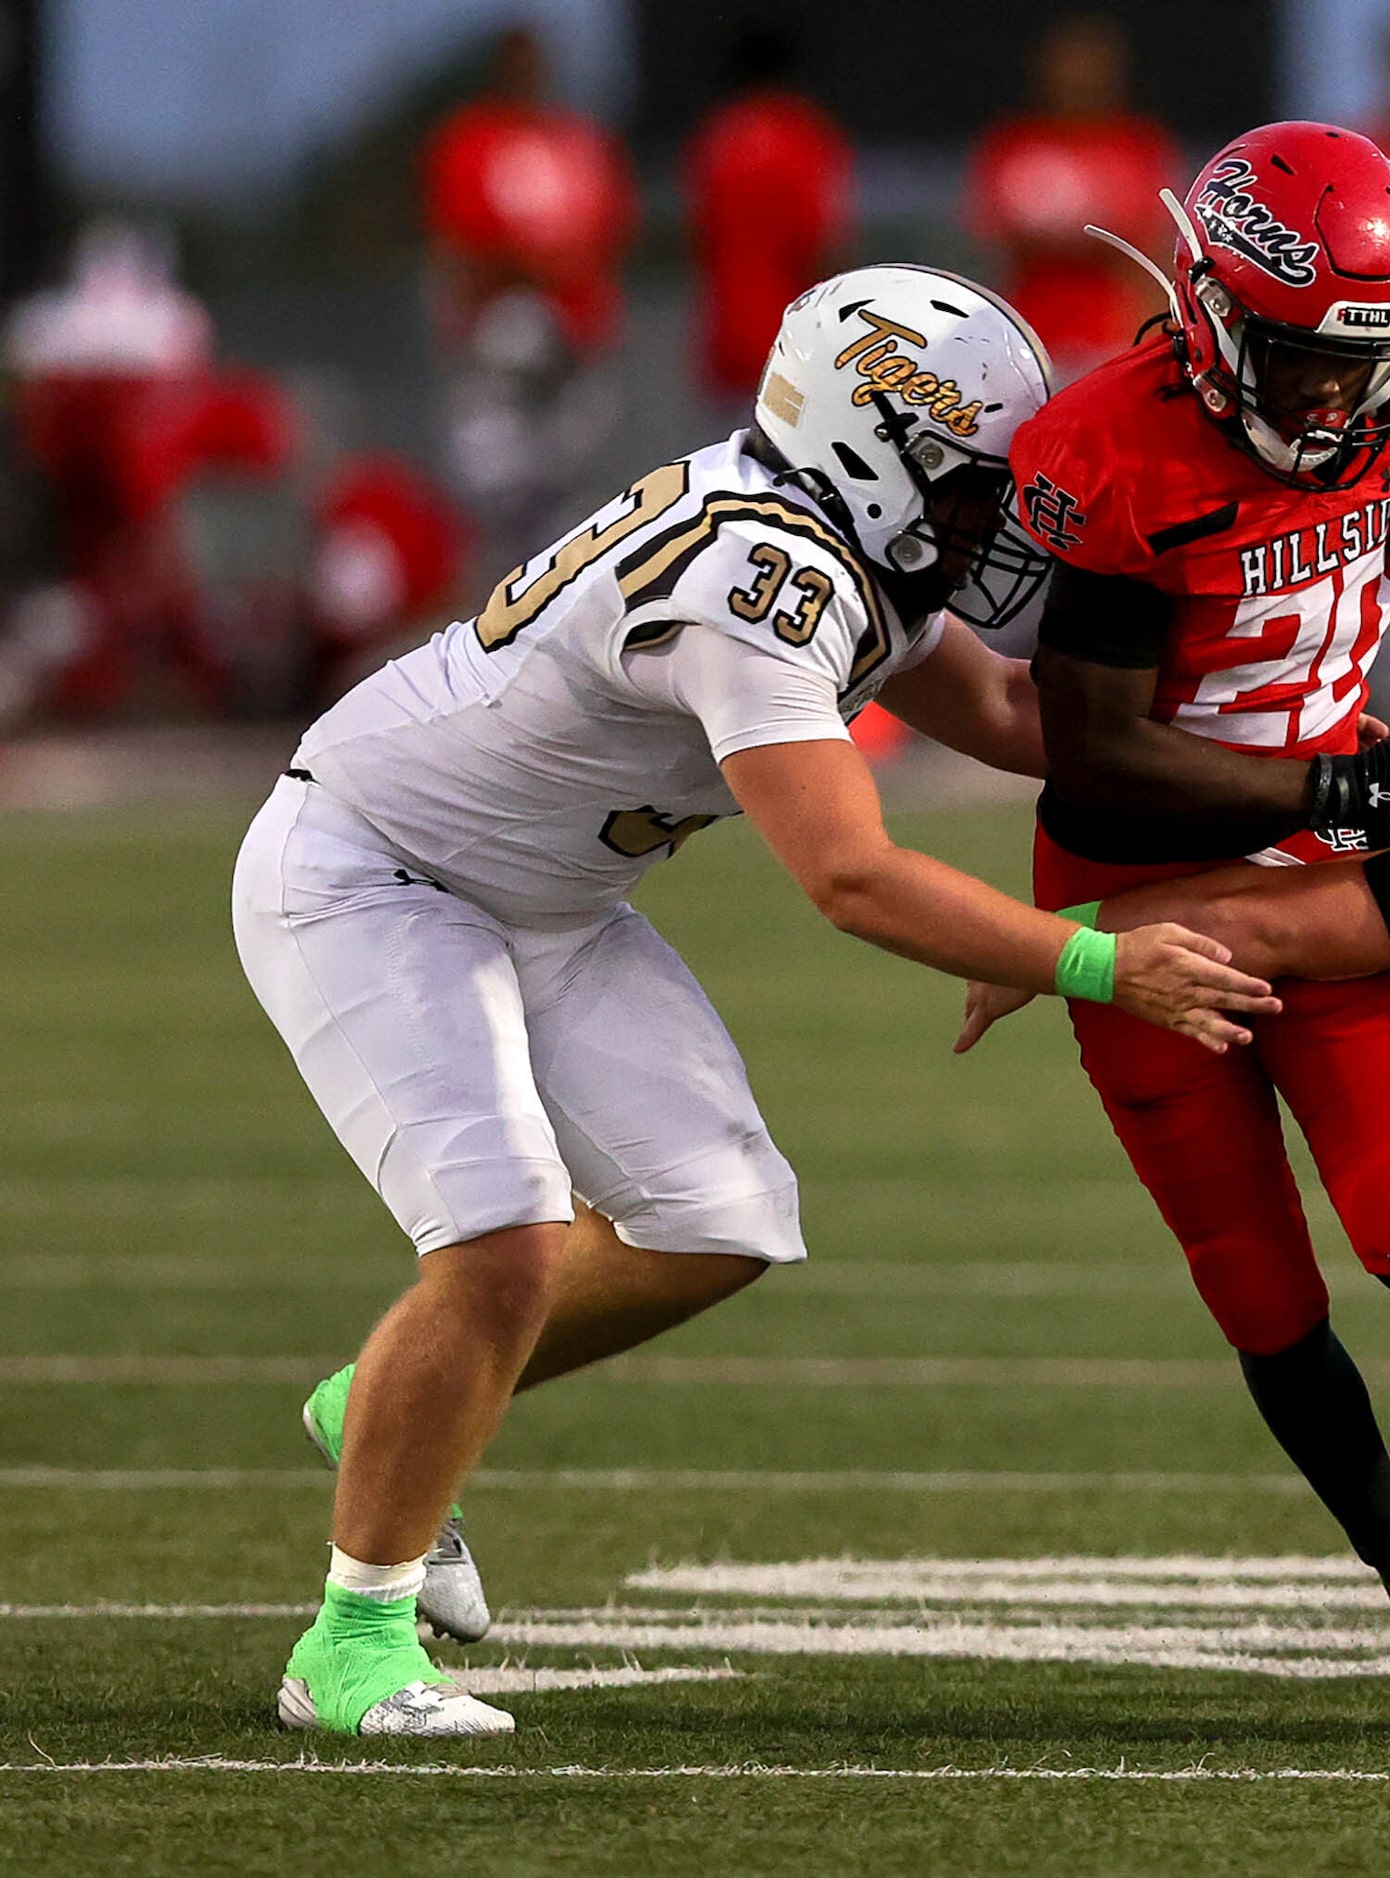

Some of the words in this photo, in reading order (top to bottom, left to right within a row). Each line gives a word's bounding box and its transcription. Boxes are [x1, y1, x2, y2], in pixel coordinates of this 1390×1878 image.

[1196, 158, 1321, 287] Horns
[834, 309, 983, 437] Tigers
[1346, 308, 1389, 324] TTHL
[727, 542, 835, 648] 33
